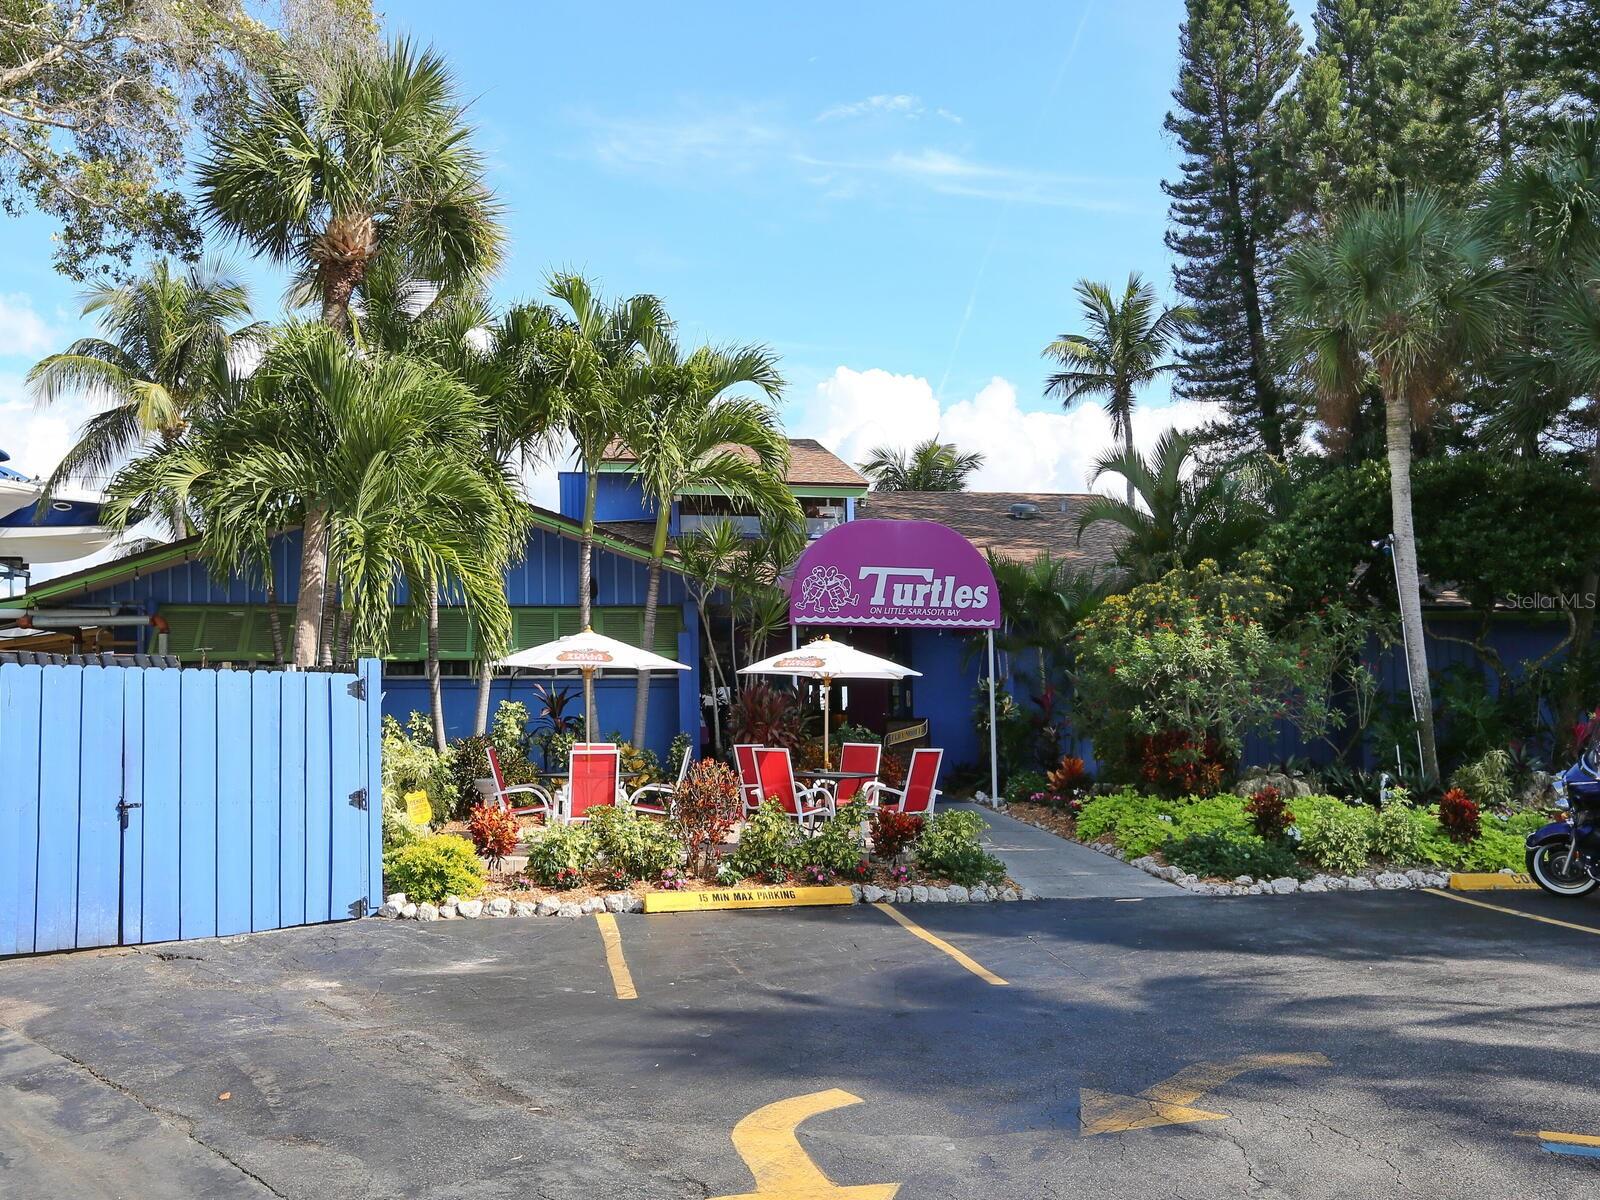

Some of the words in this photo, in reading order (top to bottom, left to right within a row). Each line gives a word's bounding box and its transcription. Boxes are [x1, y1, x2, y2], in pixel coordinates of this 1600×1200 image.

[858, 566, 989, 609] Turtles
[908, 608, 946, 616] SARASOTA
[947, 609, 961, 617] BAY
[698, 894, 708, 902] 15
[712, 893, 729, 902] MIN
[733, 892, 753, 901] MAX
[757, 890, 796, 900] PARKING
